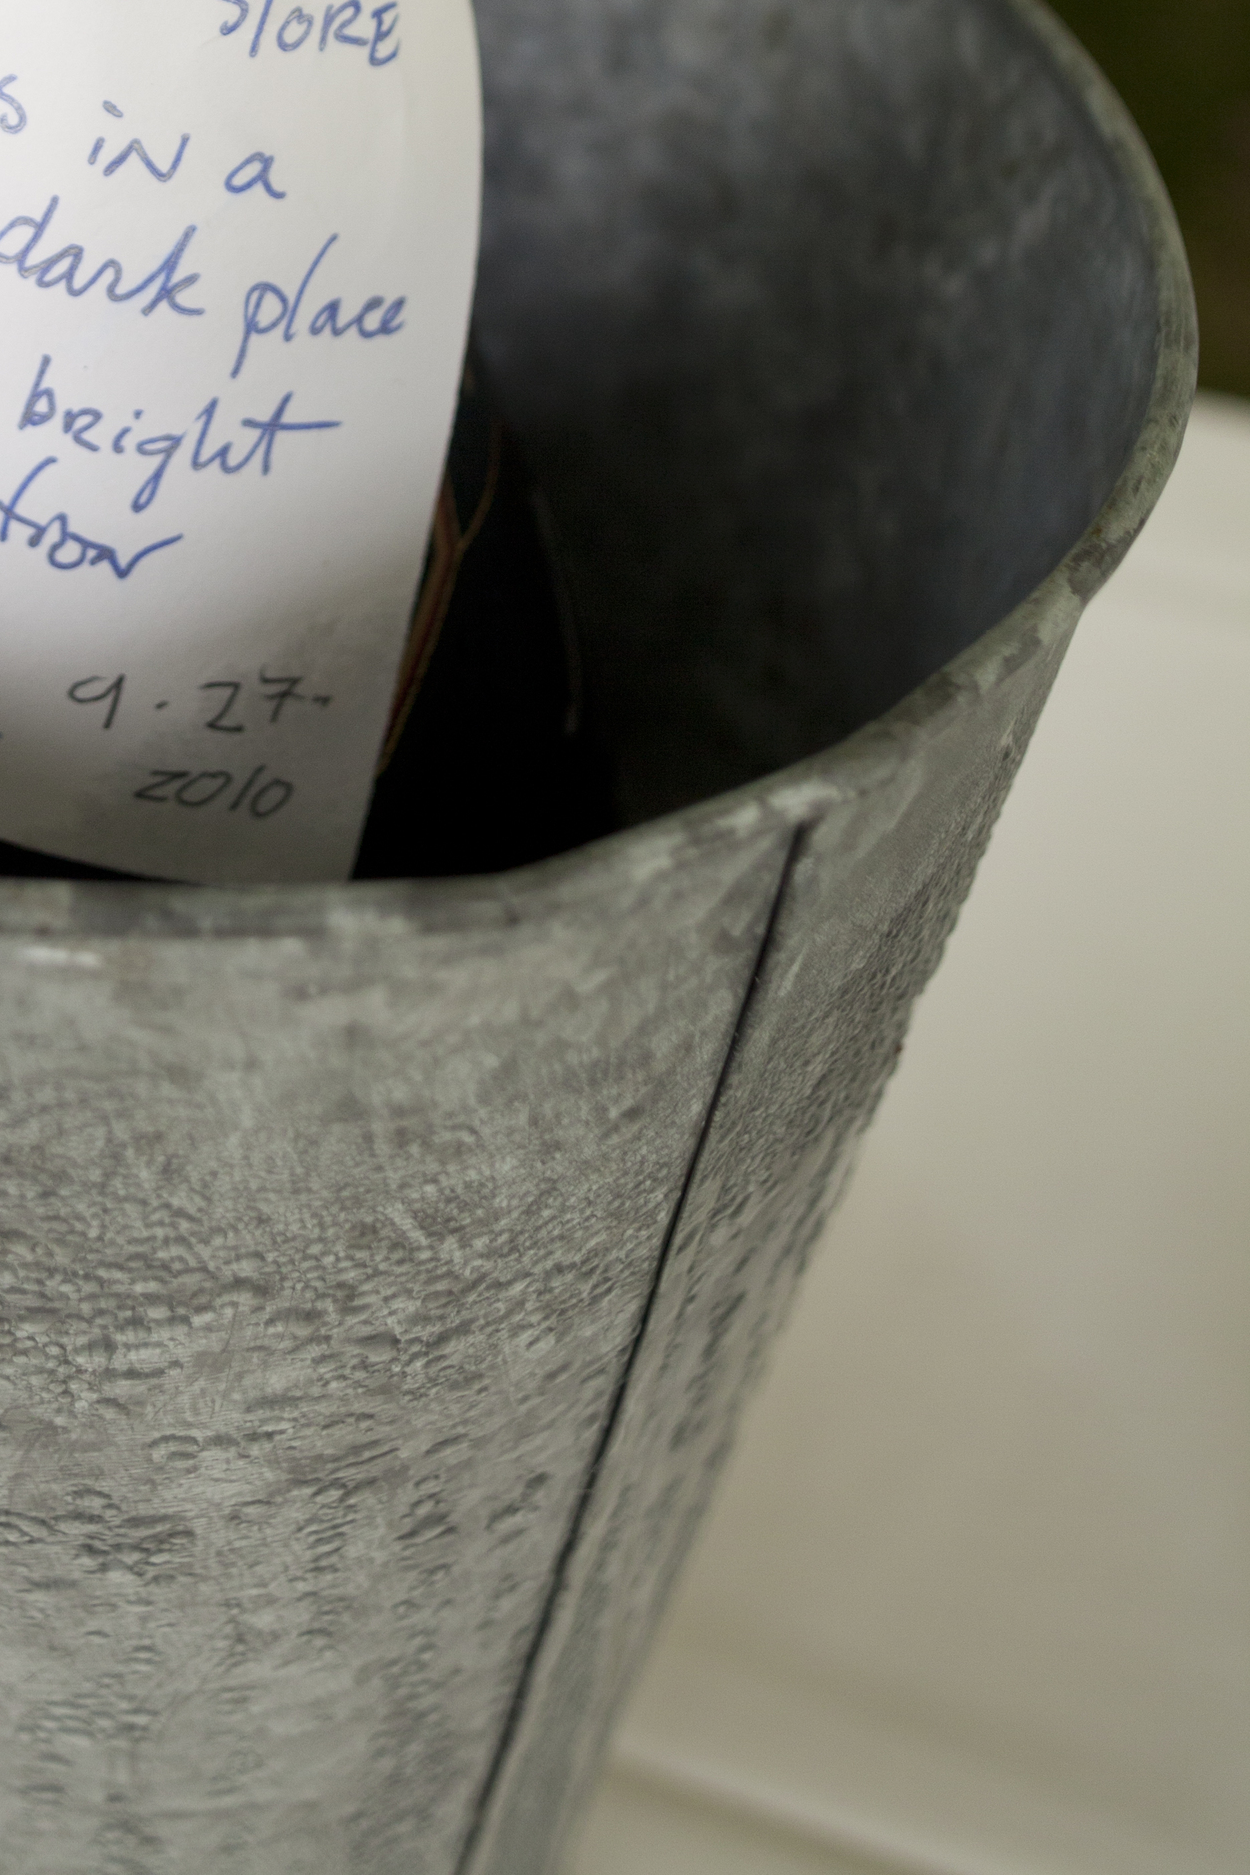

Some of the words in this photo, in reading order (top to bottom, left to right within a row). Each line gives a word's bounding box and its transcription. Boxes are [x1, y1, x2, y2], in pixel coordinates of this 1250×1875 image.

[224, 151, 287, 199] a
[231, 233, 408, 377] place
[133, 763, 293, 818] 2010
